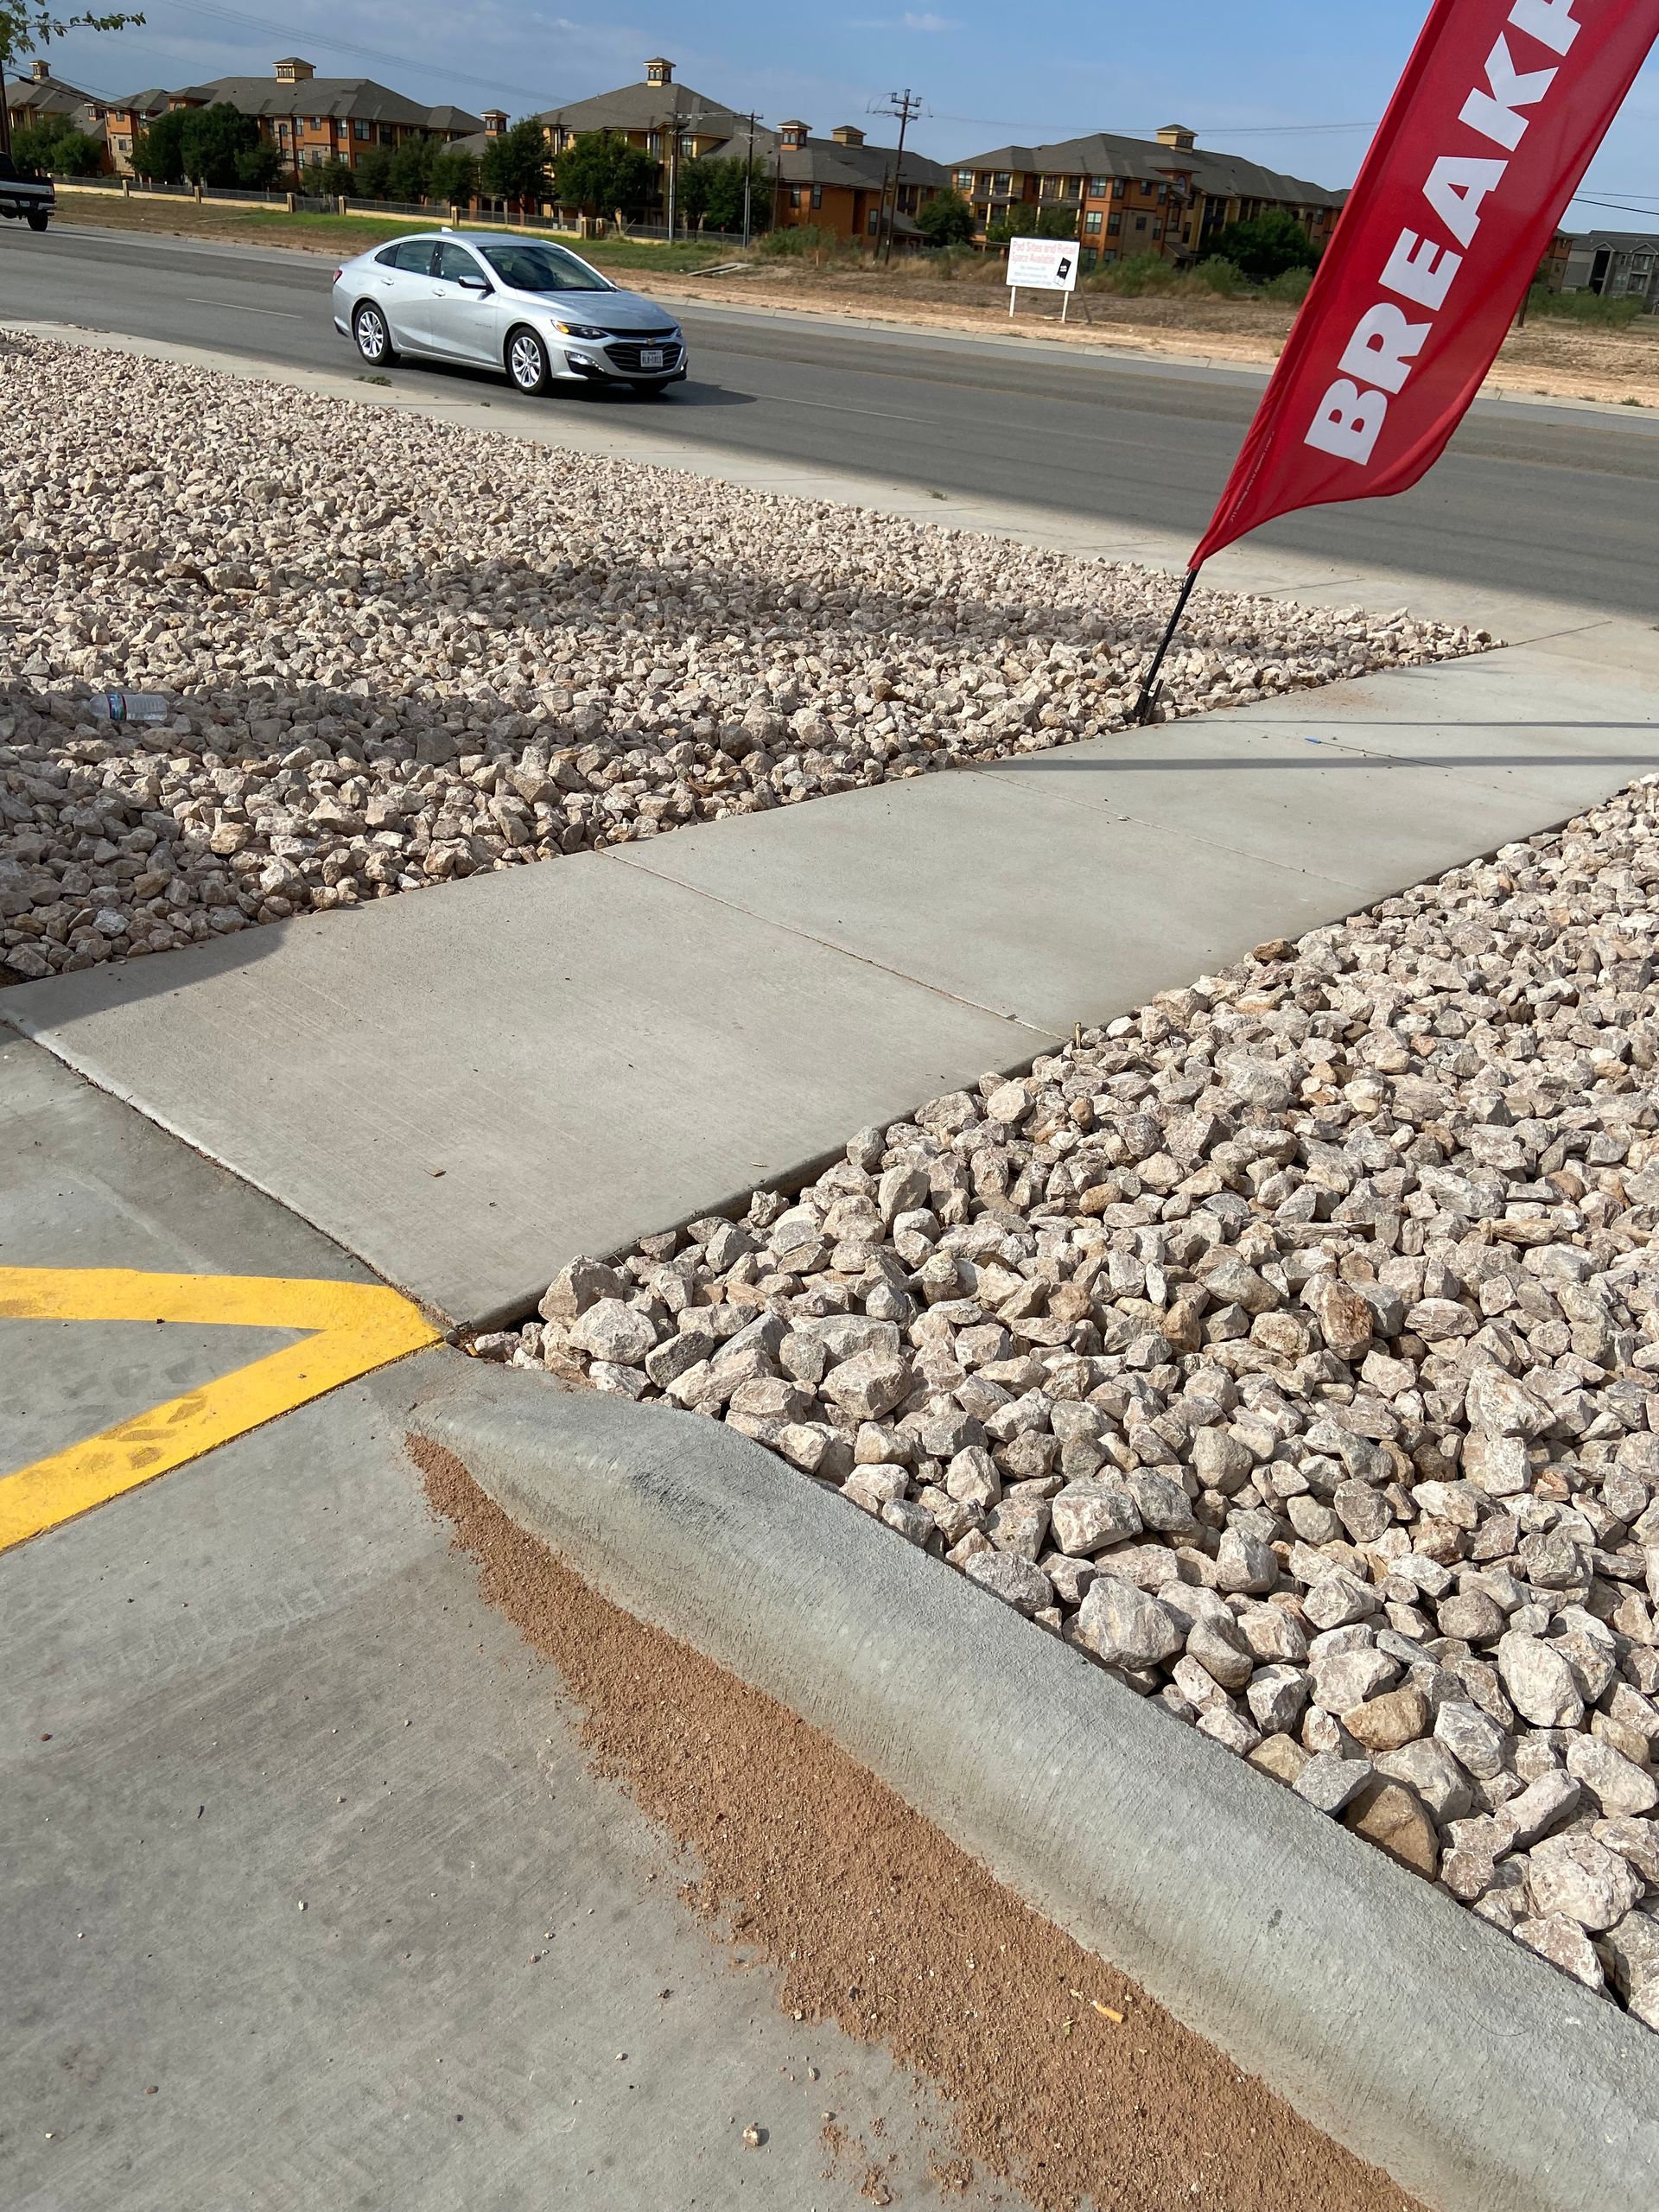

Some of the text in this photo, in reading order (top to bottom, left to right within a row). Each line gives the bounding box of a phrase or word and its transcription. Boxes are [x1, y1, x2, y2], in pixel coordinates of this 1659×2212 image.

[1013, 241, 1077, 255] Pad Sites and Retail
[1011, 251, 1055, 264] Space Available
